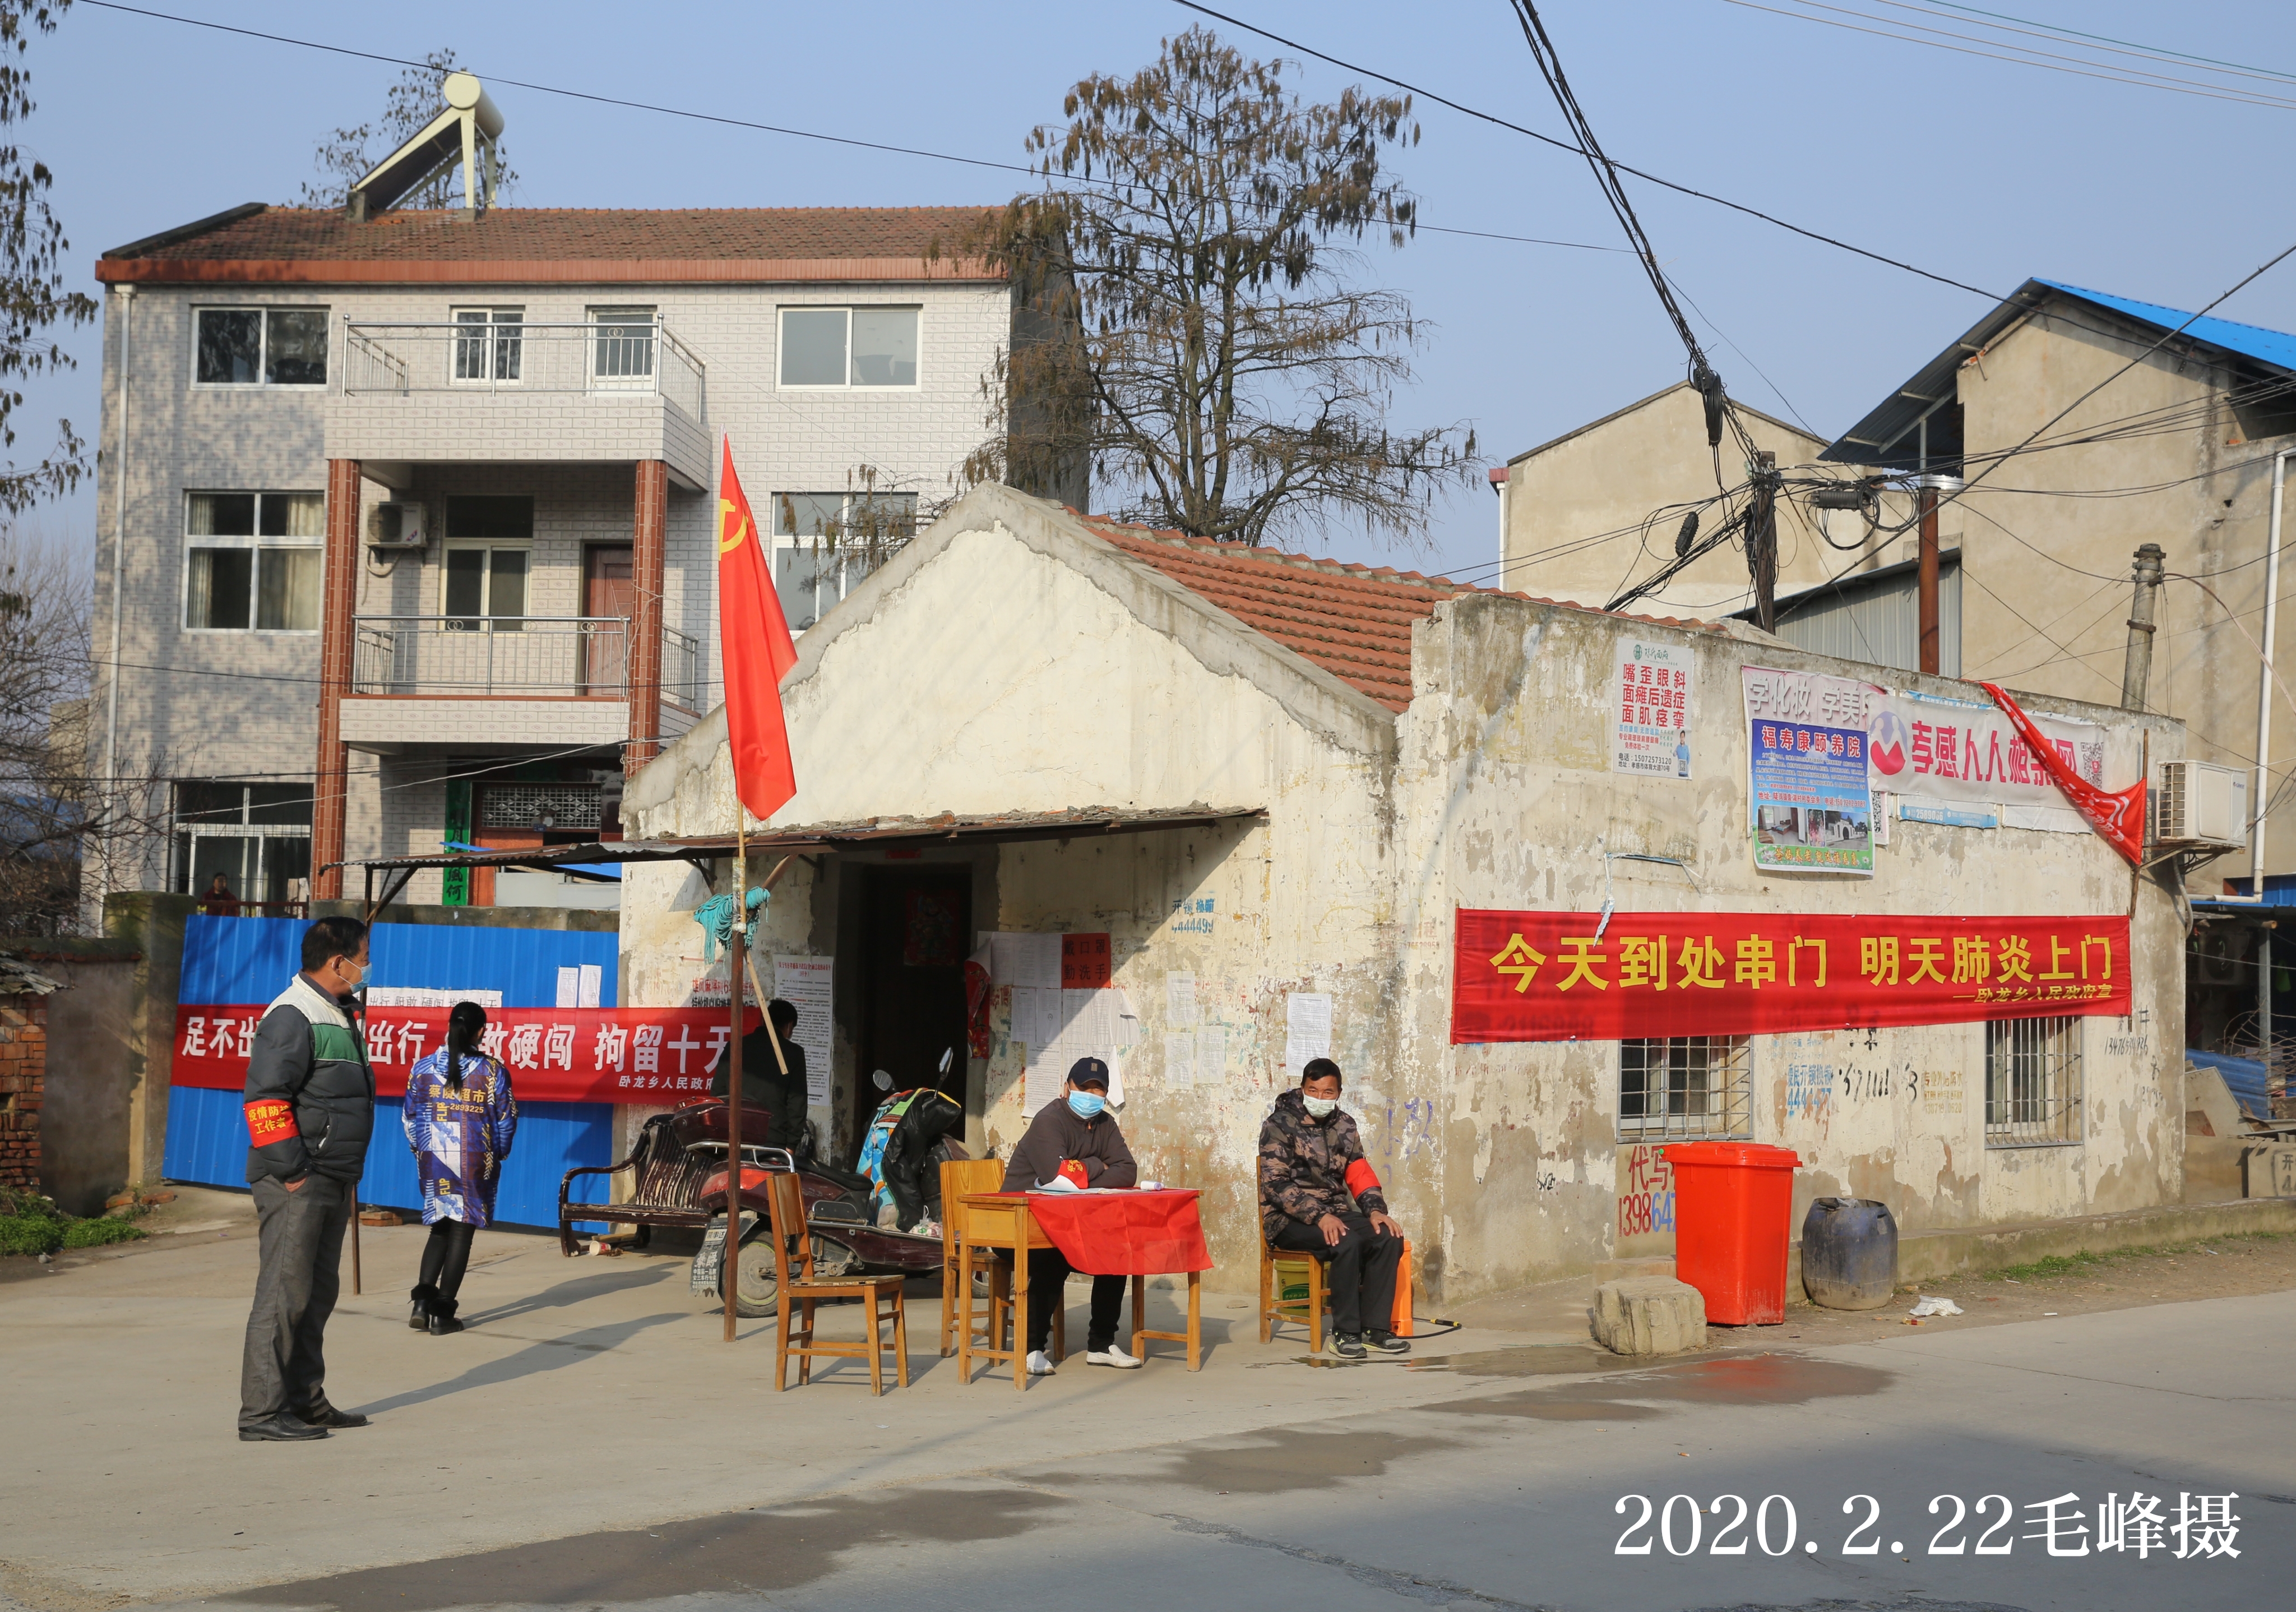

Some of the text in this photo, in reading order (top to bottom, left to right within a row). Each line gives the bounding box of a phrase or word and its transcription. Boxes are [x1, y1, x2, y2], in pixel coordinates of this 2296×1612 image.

[1623, 663, 1686, 690] 嘴歪眼斜
[1623, 683, 1685, 709] 面瘫后遗症
[1749, 674, 1811, 715] 学化妆
[1622, 704, 1685, 729] 面肌痉挛
[1624, 742, 1650, 751] 免费体验一次
[1762, 726, 1860, 757] 福寿康颐养院
[1063, 939, 1106, 956] 戴口罩
[1063, 963, 1106, 980] 勤洗手
[1489, 932, 2112, 994] 今天到处串门 明天肺炎上门
[182, 1017, 258, 1057] 足不出
[368, 1020, 428, 1065] 出行
[478, 1021, 576, 1071] 敢硬闯
[255, 1117, 286, 1134] 工作者
[1628, 1145, 1675, 1193] 代写
[2282, 1154, 2296, 1171] 开
[439, 1178, 451, 1195] FLIP
[2282, 1175, 2296, 1195] 4
